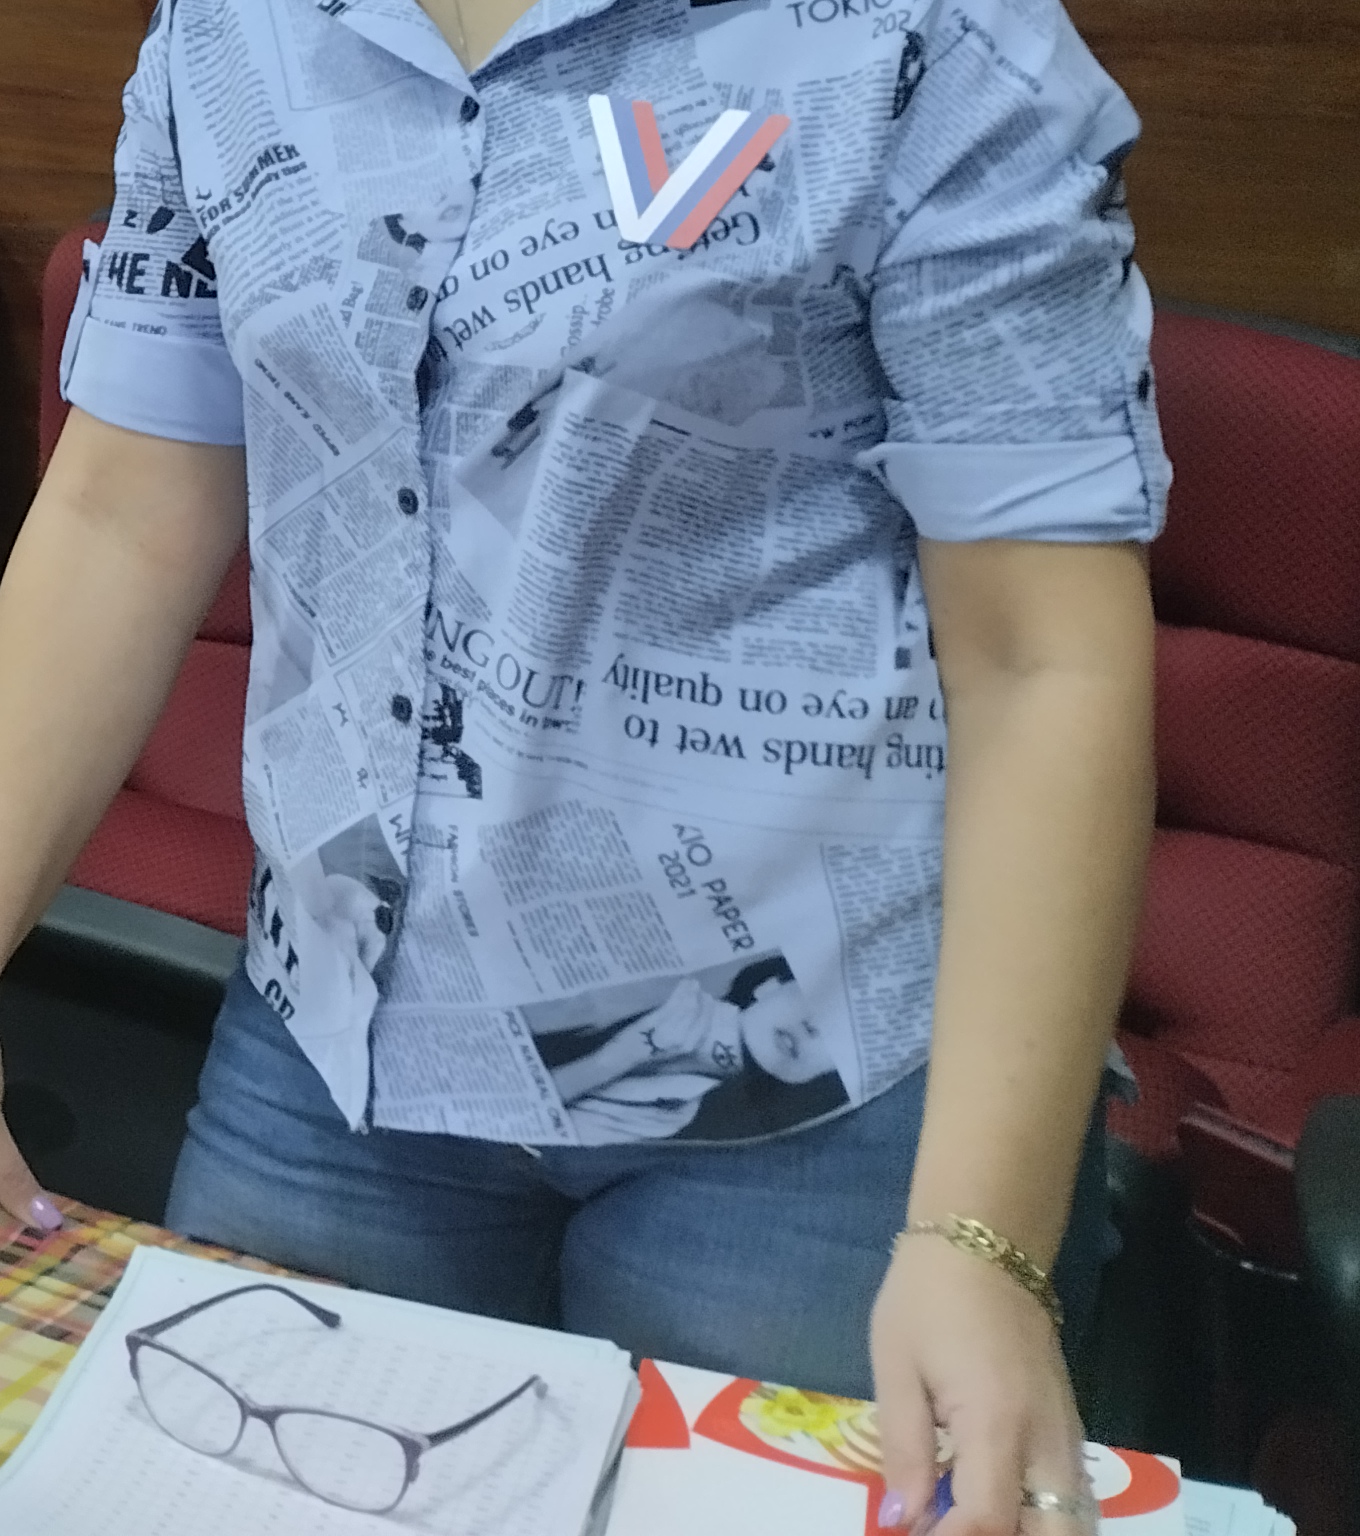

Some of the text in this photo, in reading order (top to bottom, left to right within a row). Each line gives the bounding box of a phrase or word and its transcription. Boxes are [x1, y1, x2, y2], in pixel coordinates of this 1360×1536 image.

[872, 9, 912, 40] 202
[520, 217, 580, 257] eye
[617, 211, 760, 266] Getng
[469, 248, 510, 282] on
[503, 253, 615, 315] hands
[443, 304, 497, 352] wet
[496, 652, 587, 712] OUT!
[601, 652, 724, 707] quality
[738, 686, 788, 715] on
[801, 689, 870, 720] eye
[623, 713, 660, 748] to
[676, 723, 747, 760] wet
[762, 737, 877, 780] hands
[658, 848, 697, 899] 2021
[701, 877, 756, 953] PAPER
